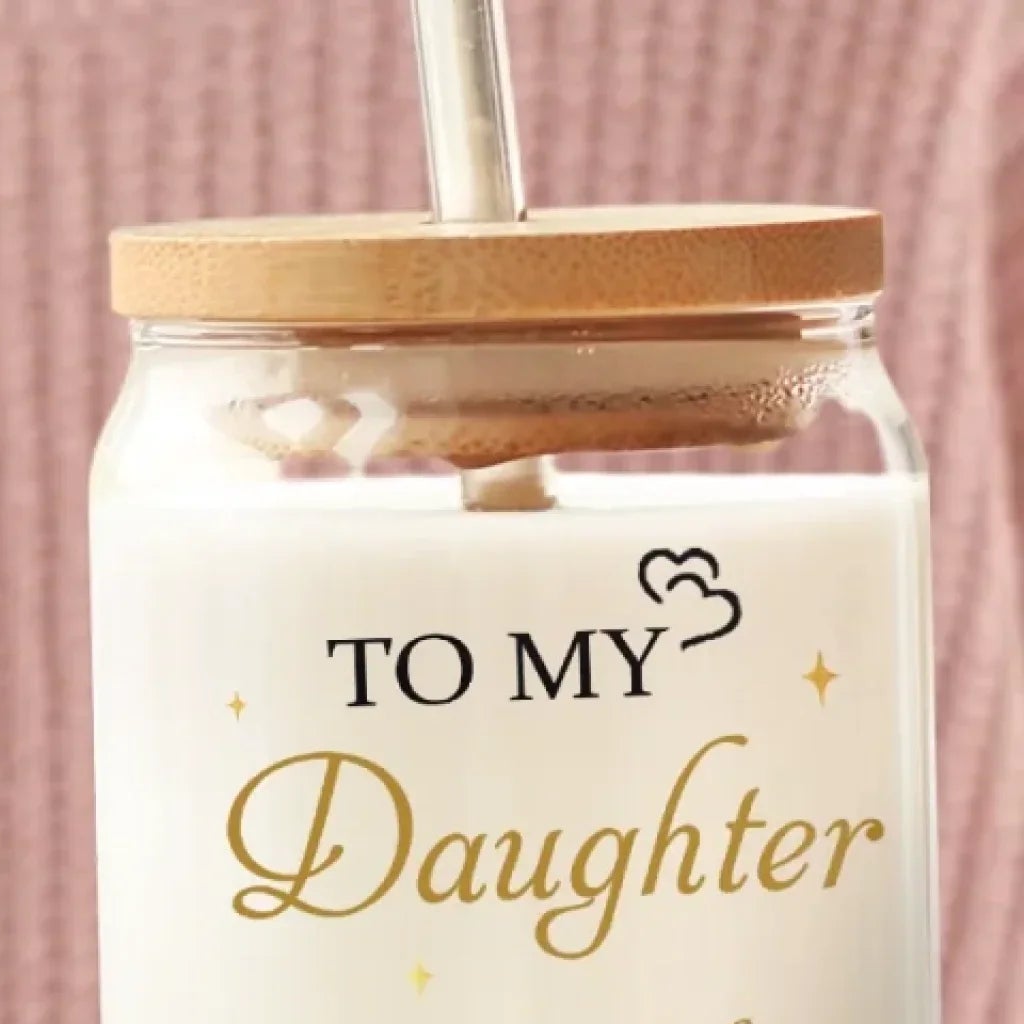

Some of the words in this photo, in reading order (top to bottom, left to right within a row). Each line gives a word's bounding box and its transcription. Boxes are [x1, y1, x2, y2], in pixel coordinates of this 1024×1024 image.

[326, 633, 474, 707] TO
[507, 626, 669, 701] MY
[226, 735, 885, 960] Daughter
